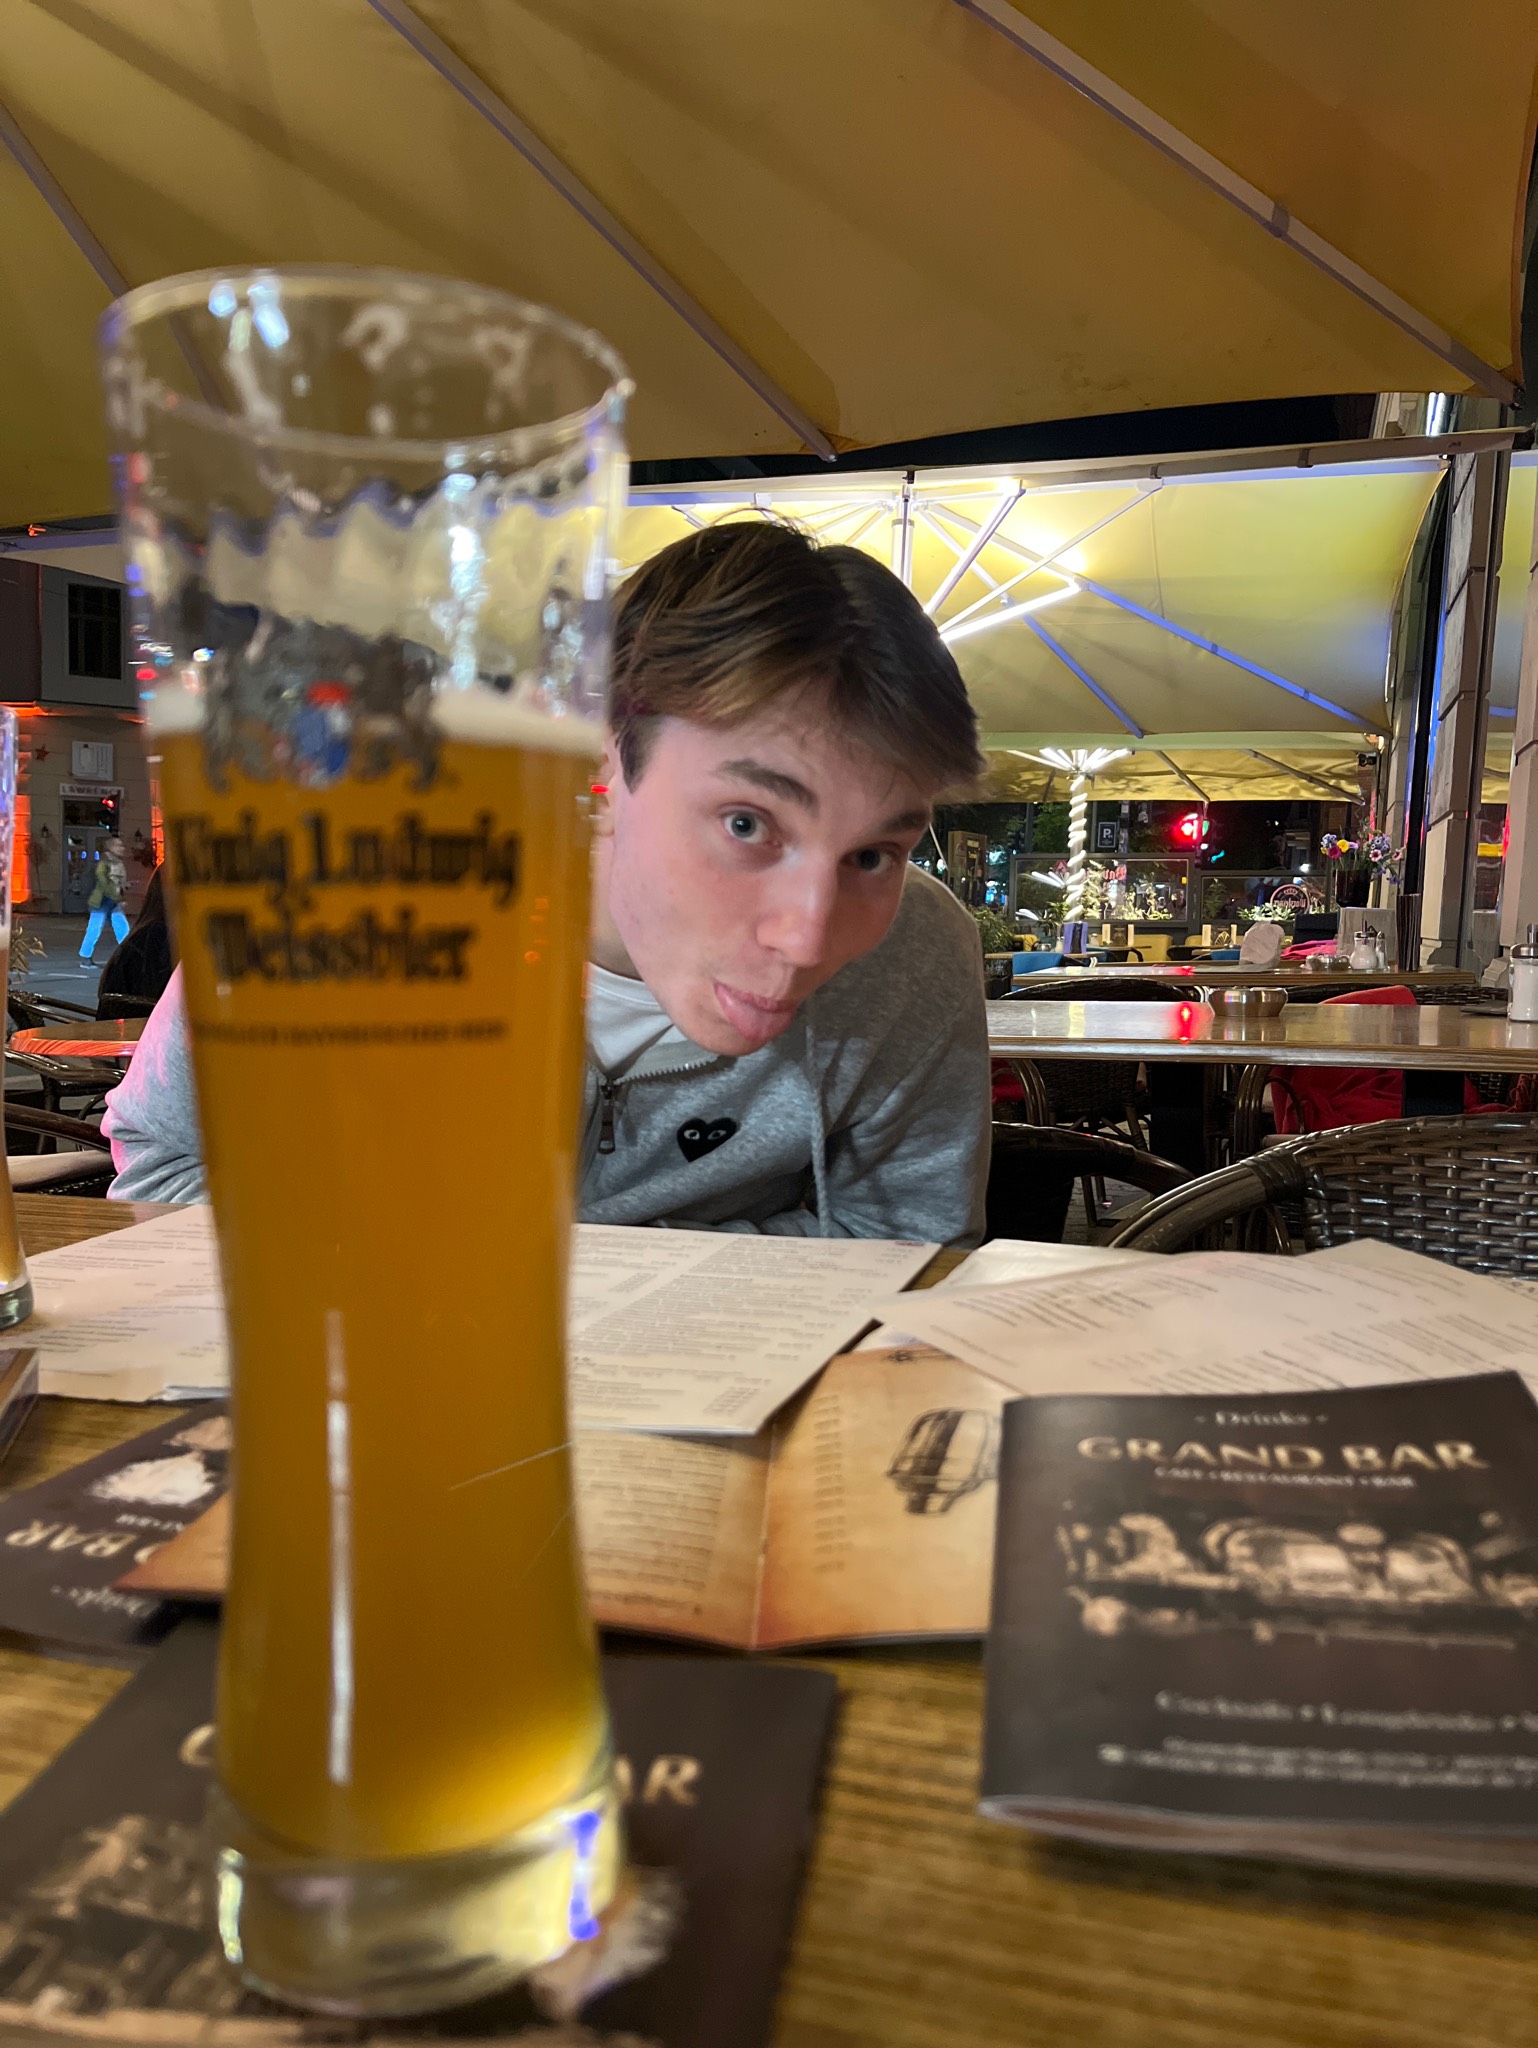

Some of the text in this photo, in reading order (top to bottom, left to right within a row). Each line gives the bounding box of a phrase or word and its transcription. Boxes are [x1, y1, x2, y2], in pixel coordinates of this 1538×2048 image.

[60, 785, 121, 796] LAWRENC
[1076, 1435, 1491, 1472] GRAND BAR
[4, 1518, 138, 1558] BAR
